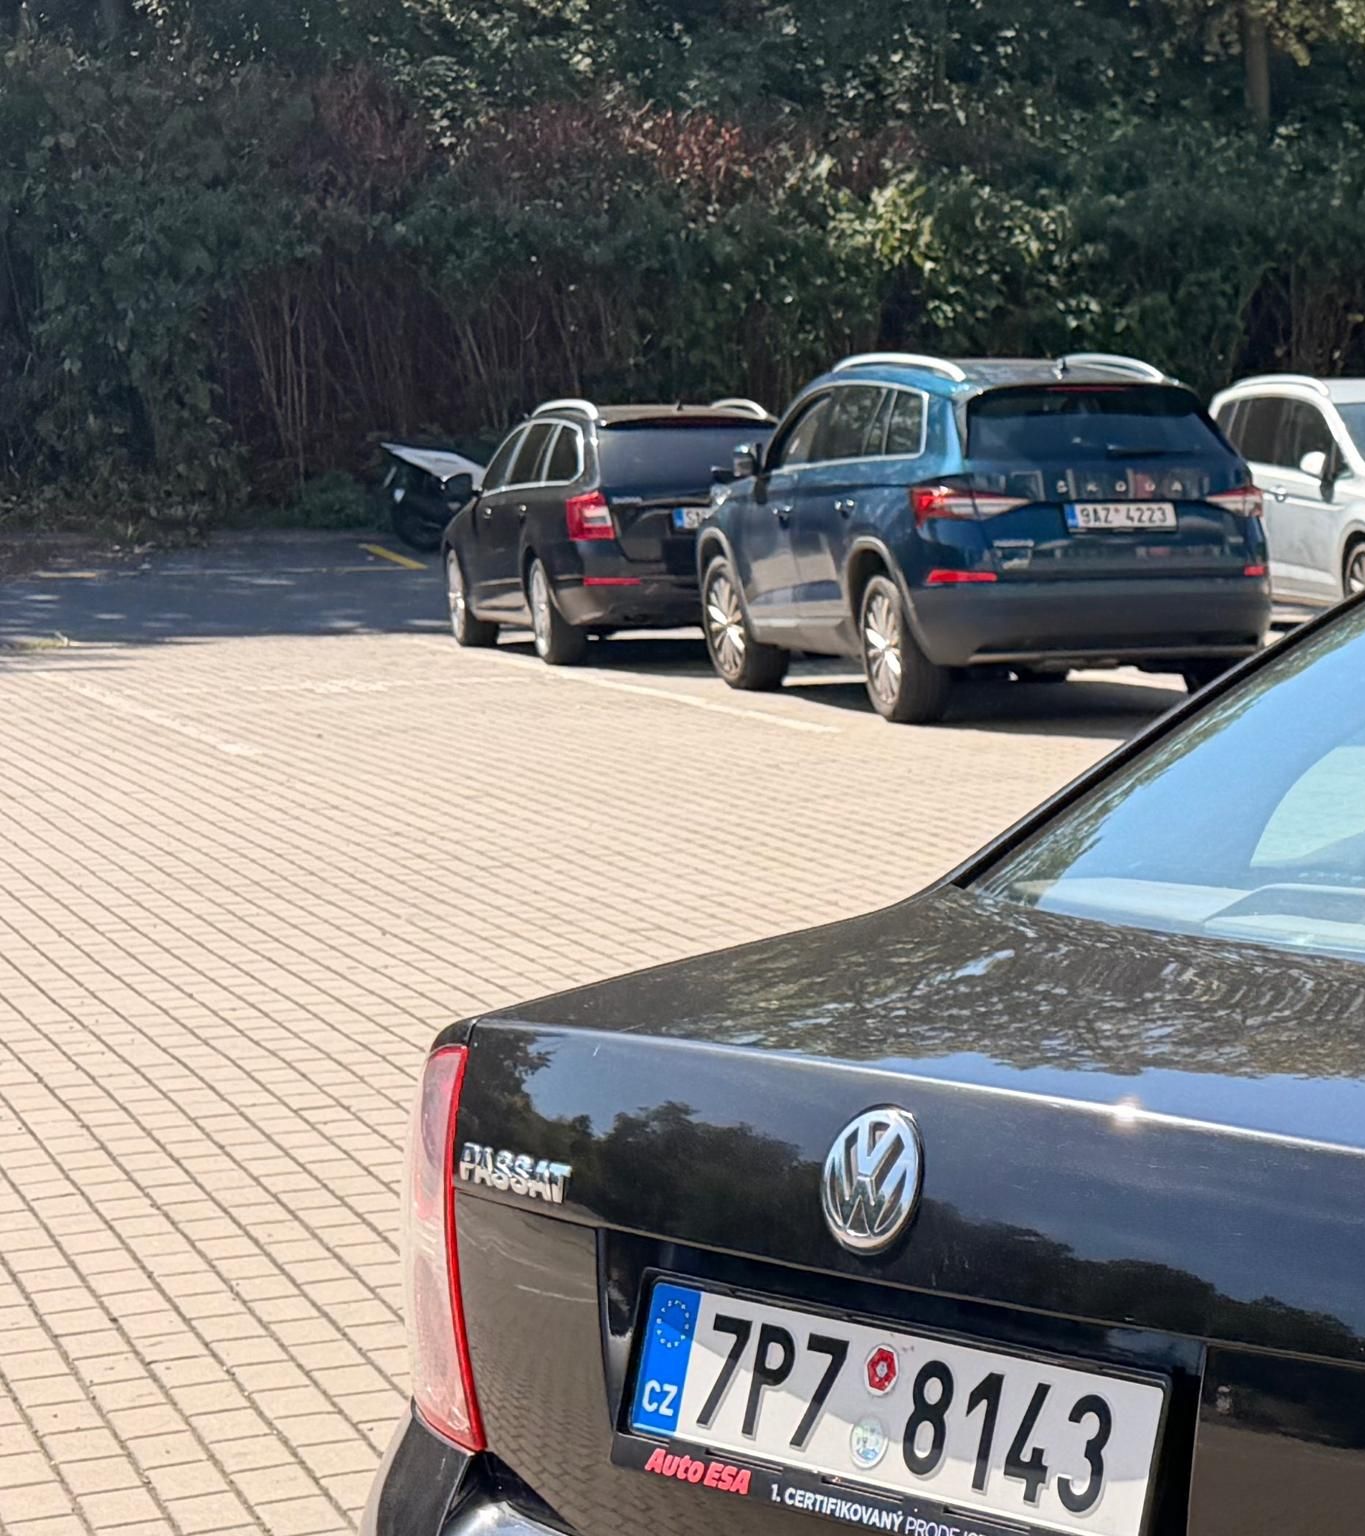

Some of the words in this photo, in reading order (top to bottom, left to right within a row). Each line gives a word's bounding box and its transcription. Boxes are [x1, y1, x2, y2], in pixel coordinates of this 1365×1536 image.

[1125, 507, 1168, 523] 4223
[460, 1142, 573, 1204] PASSAT
[822, 1108, 923, 1253] VW
[642, 1379, 677, 1417] CZ
[697, 1313, 850, 1448] 7P7
[903, 1360, 1113, 1514] 8143
[645, 1447, 704, 1484] Auto
[703, 1461, 752, 1496] ESA
[770, 1483, 782, 1503] 1.
[784, 1487, 905, 1533] CERTIFIKOVANÝ
